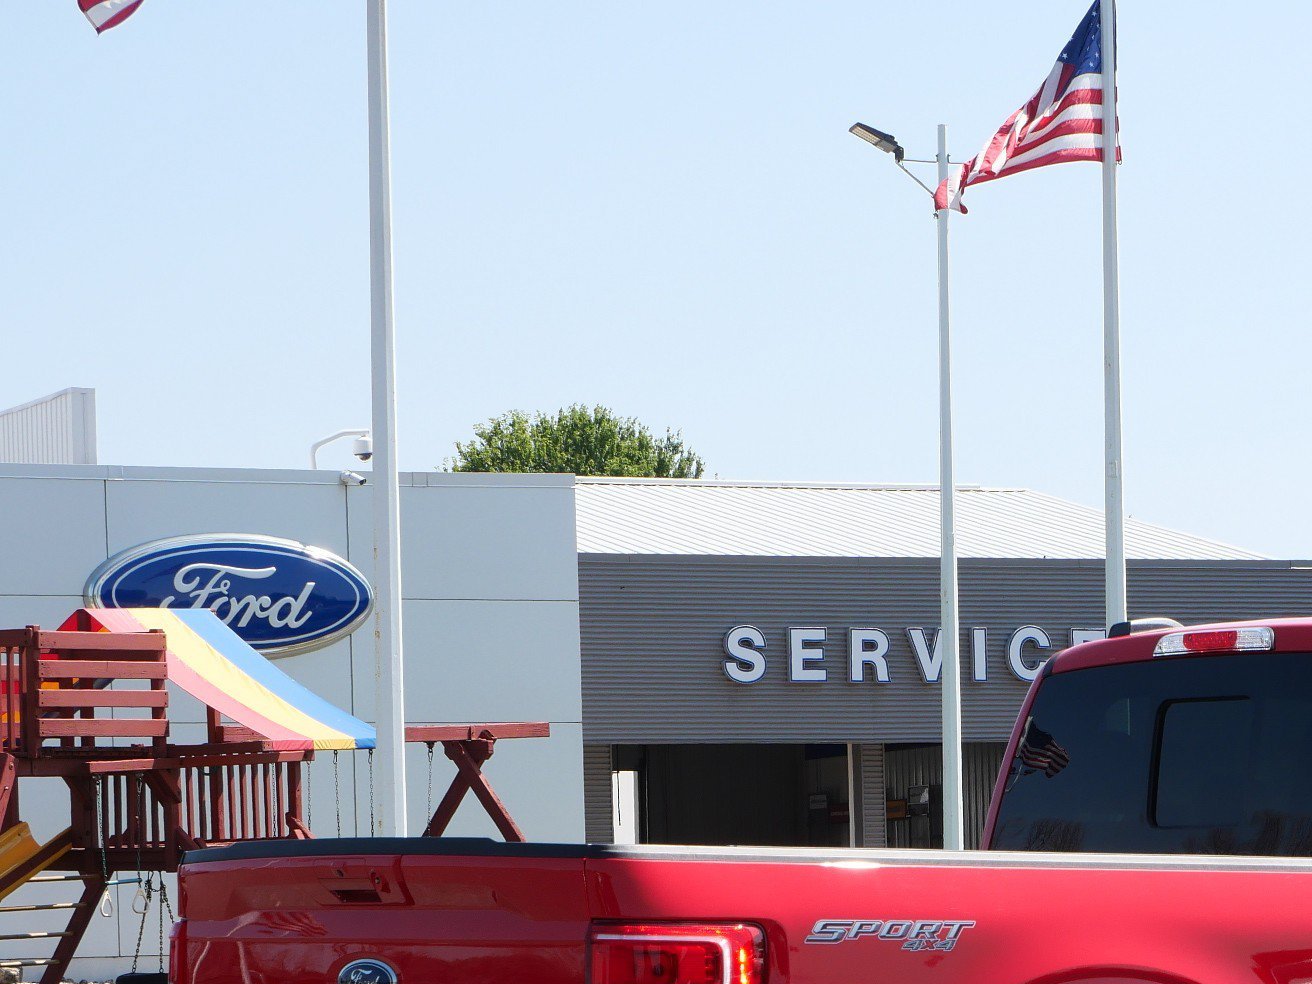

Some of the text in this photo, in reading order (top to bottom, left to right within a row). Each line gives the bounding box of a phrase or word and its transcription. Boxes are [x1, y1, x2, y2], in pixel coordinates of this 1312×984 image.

[160, 563, 316, 629] Ford
[724, 625, 1107, 683] SERVIC
[804, 920, 976, 944] SPORT
